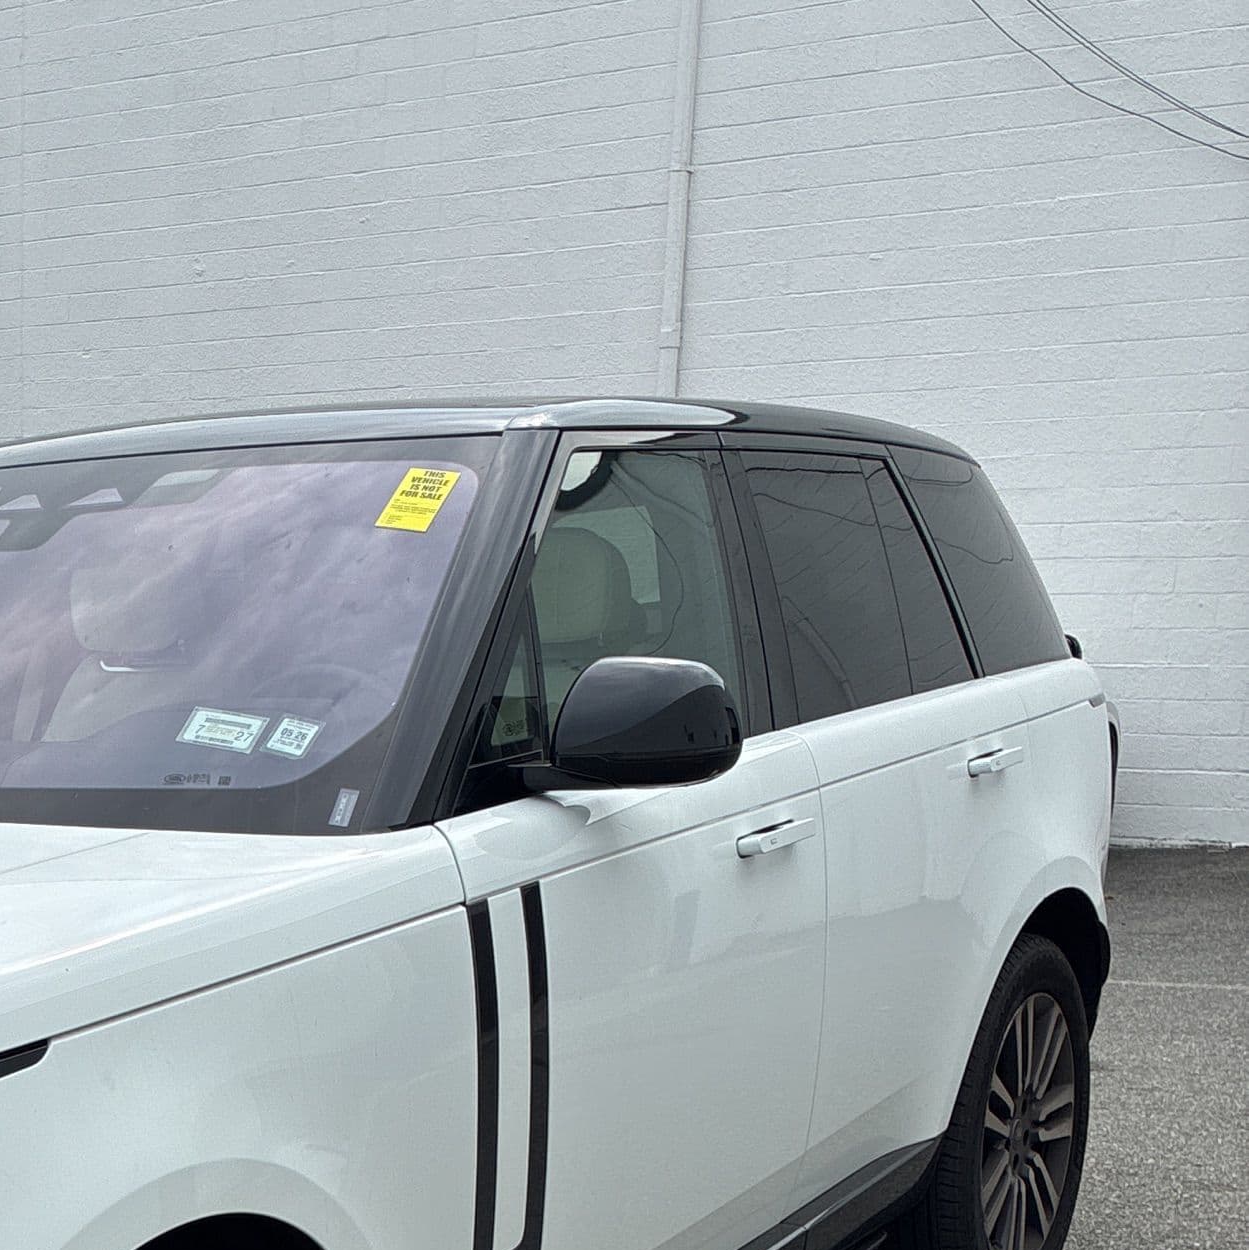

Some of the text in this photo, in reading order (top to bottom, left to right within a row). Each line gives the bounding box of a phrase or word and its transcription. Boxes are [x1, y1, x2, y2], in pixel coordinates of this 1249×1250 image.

[424, 470, 446, 478] THIS
[411, 476, 450, 487] VEHICLE
[410, 483, 421, 491] IS
[400, 490, 444, 500] FOR SALE
[235, 731, 254, 743] 27
[280, 727, 294, 737] 05
